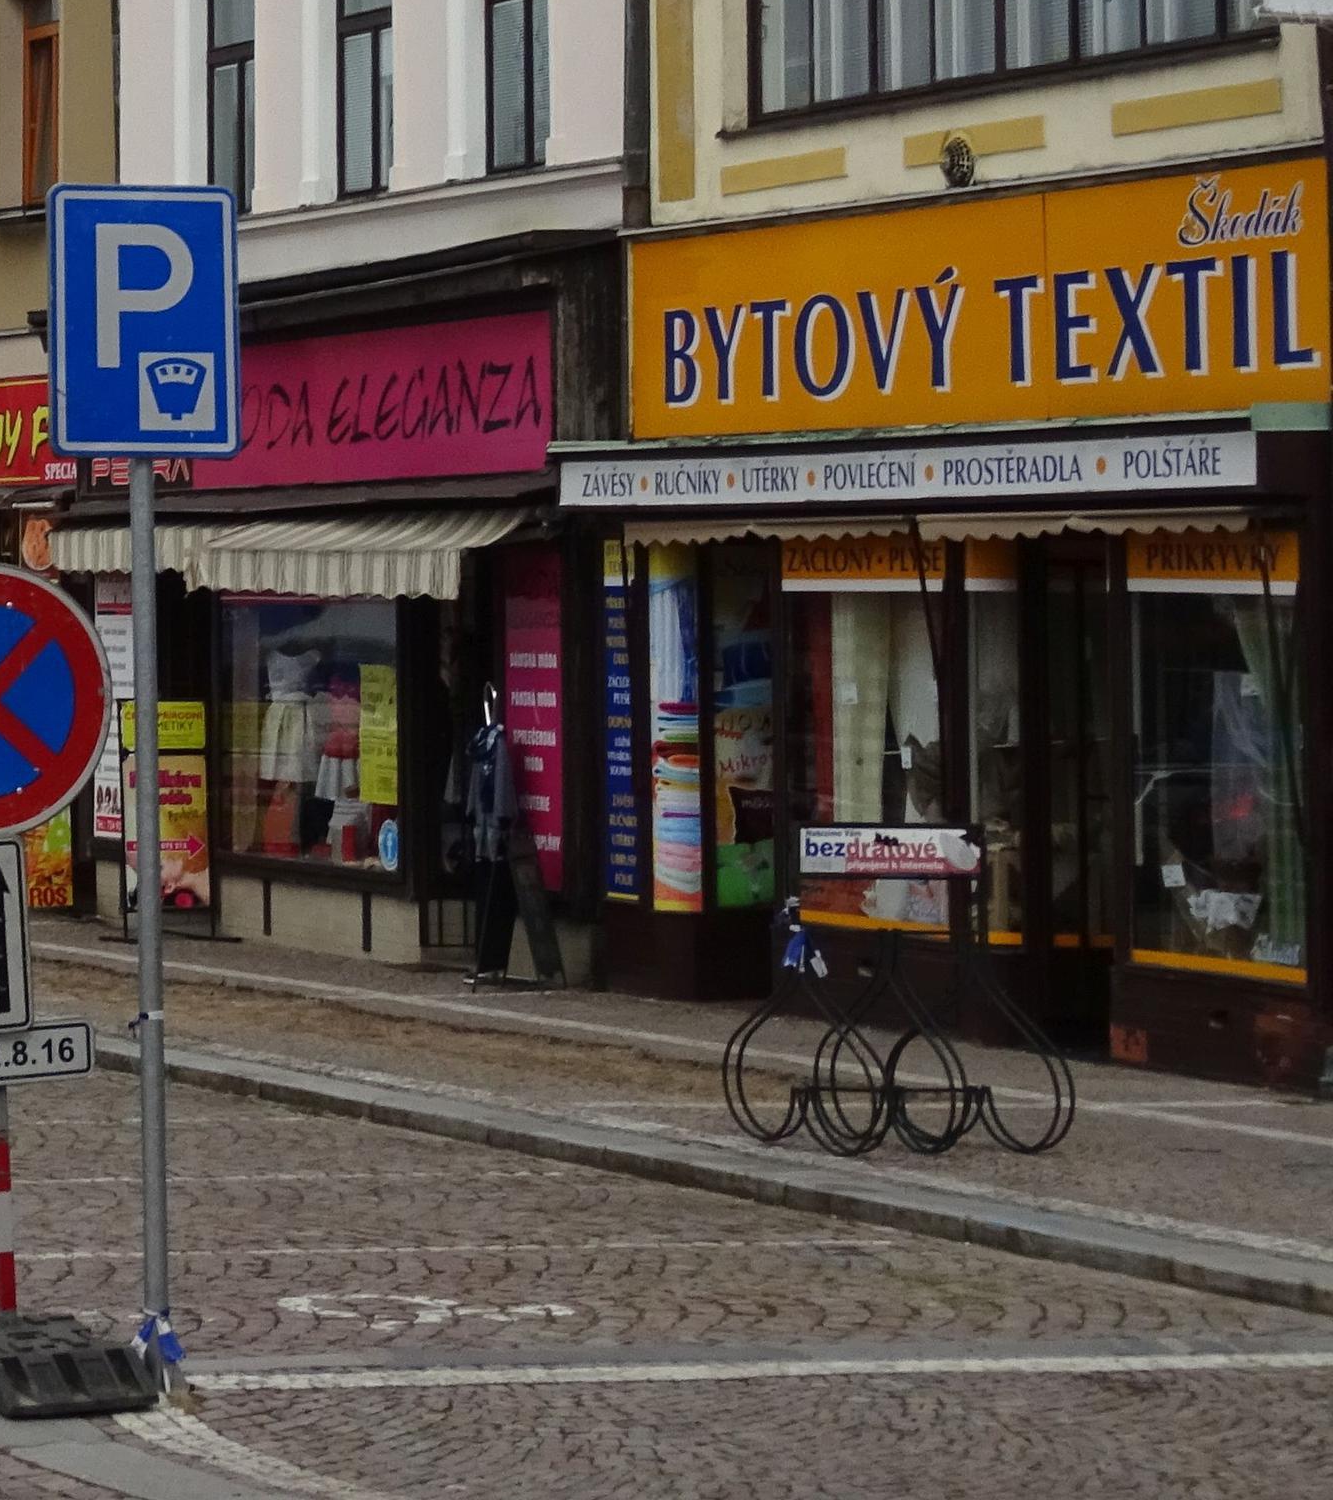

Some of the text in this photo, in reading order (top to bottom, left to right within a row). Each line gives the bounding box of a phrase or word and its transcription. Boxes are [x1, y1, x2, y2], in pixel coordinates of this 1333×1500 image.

[95, 223, 195, 369] P
[664, 249, 1322, 408] BYTOVÝ TEXTIL
[241, 355, 543, 451] ODA ELEGANZA
[44, 461, 78, 481] SPECIA
[91, 457, 191, 487] PERA
[582, 437, 1222, 497] ZÁVĚSY RUČNÍKY UTĚRKY POVLEČENÍ PROSTĚRADLA POLŠTÁŘE
[29, 886, 68, 907] ROS
